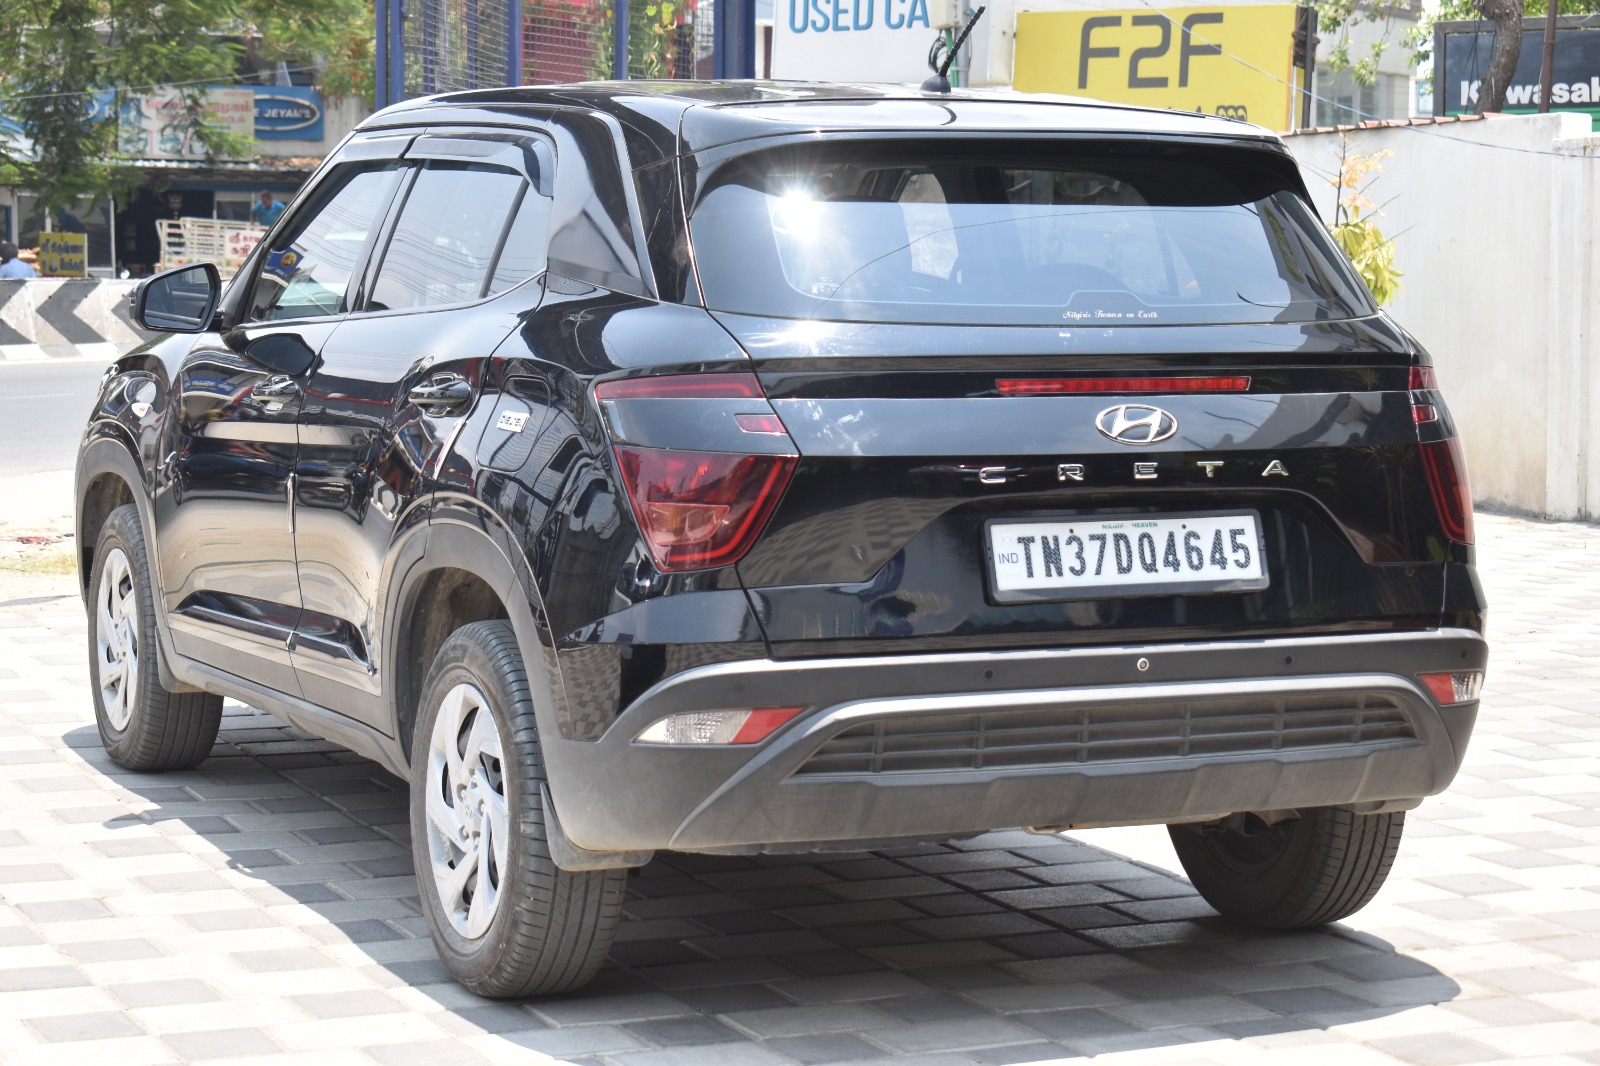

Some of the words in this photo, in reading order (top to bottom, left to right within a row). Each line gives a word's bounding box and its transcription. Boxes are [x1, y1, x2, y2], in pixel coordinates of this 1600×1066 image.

[789, 0, 874, 33] USED
[1078, 13, 1224, 89] F2F
[978, 459, 1290, 484] CRETA
[998, 552, 1019, 564] IND
[1017, 528, 1252, 578] TN37DQ4645
